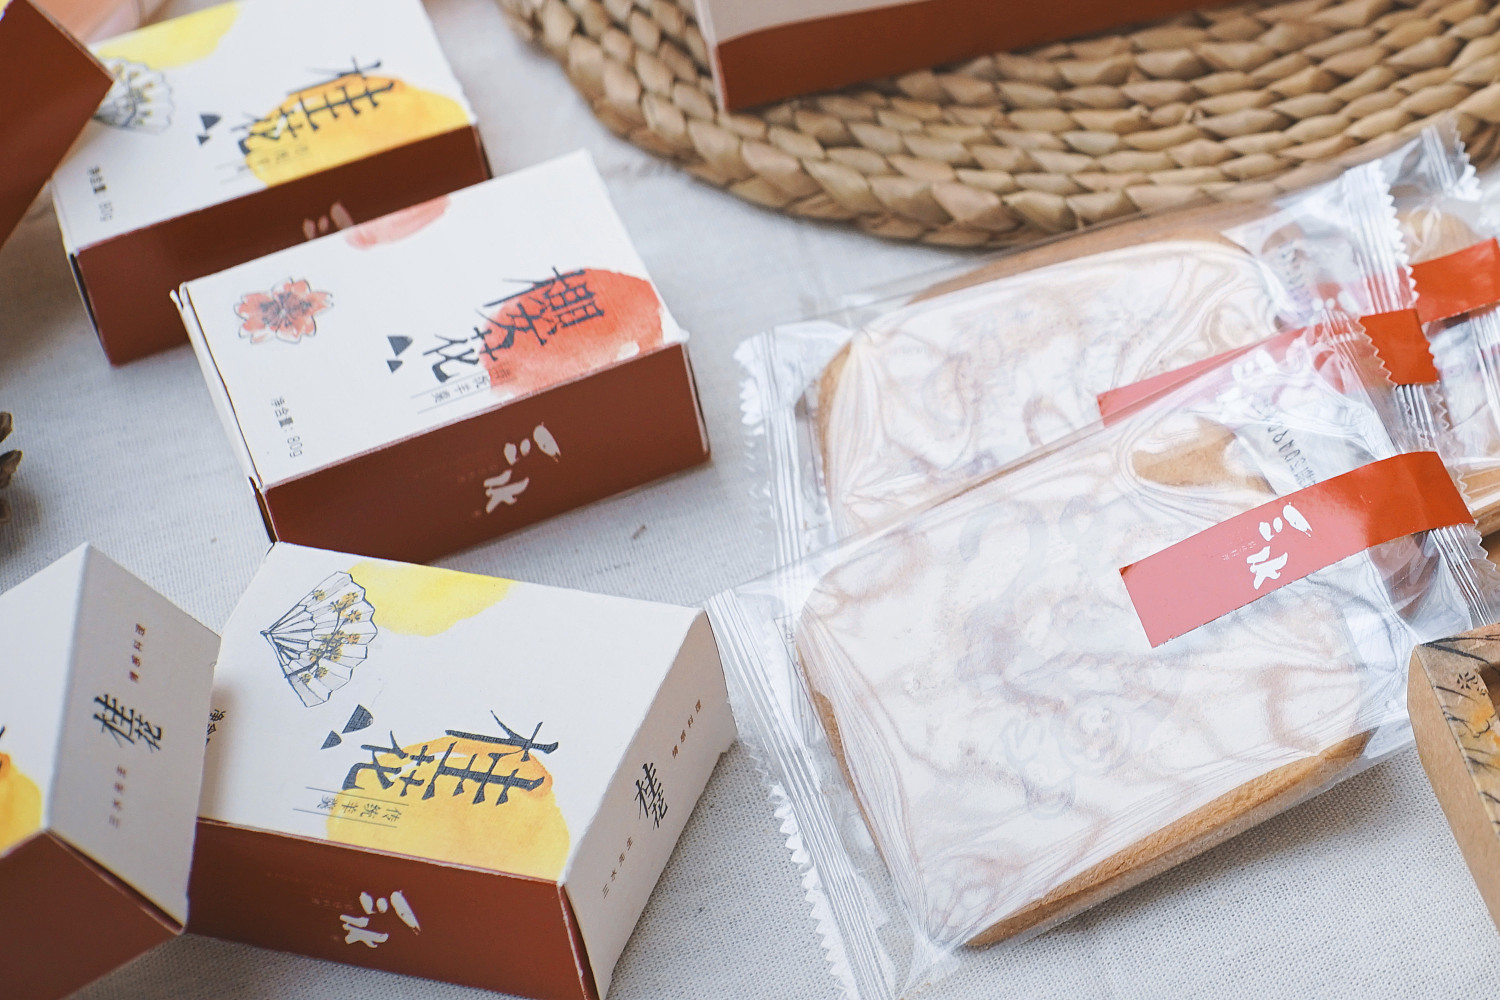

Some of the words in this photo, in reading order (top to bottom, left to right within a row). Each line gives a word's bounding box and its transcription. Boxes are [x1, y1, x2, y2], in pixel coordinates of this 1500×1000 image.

[93, 693, 162, 754] 桂花
[343, 709, 560, 806] 桂花
[634, 762, 669, 831] 桂花
